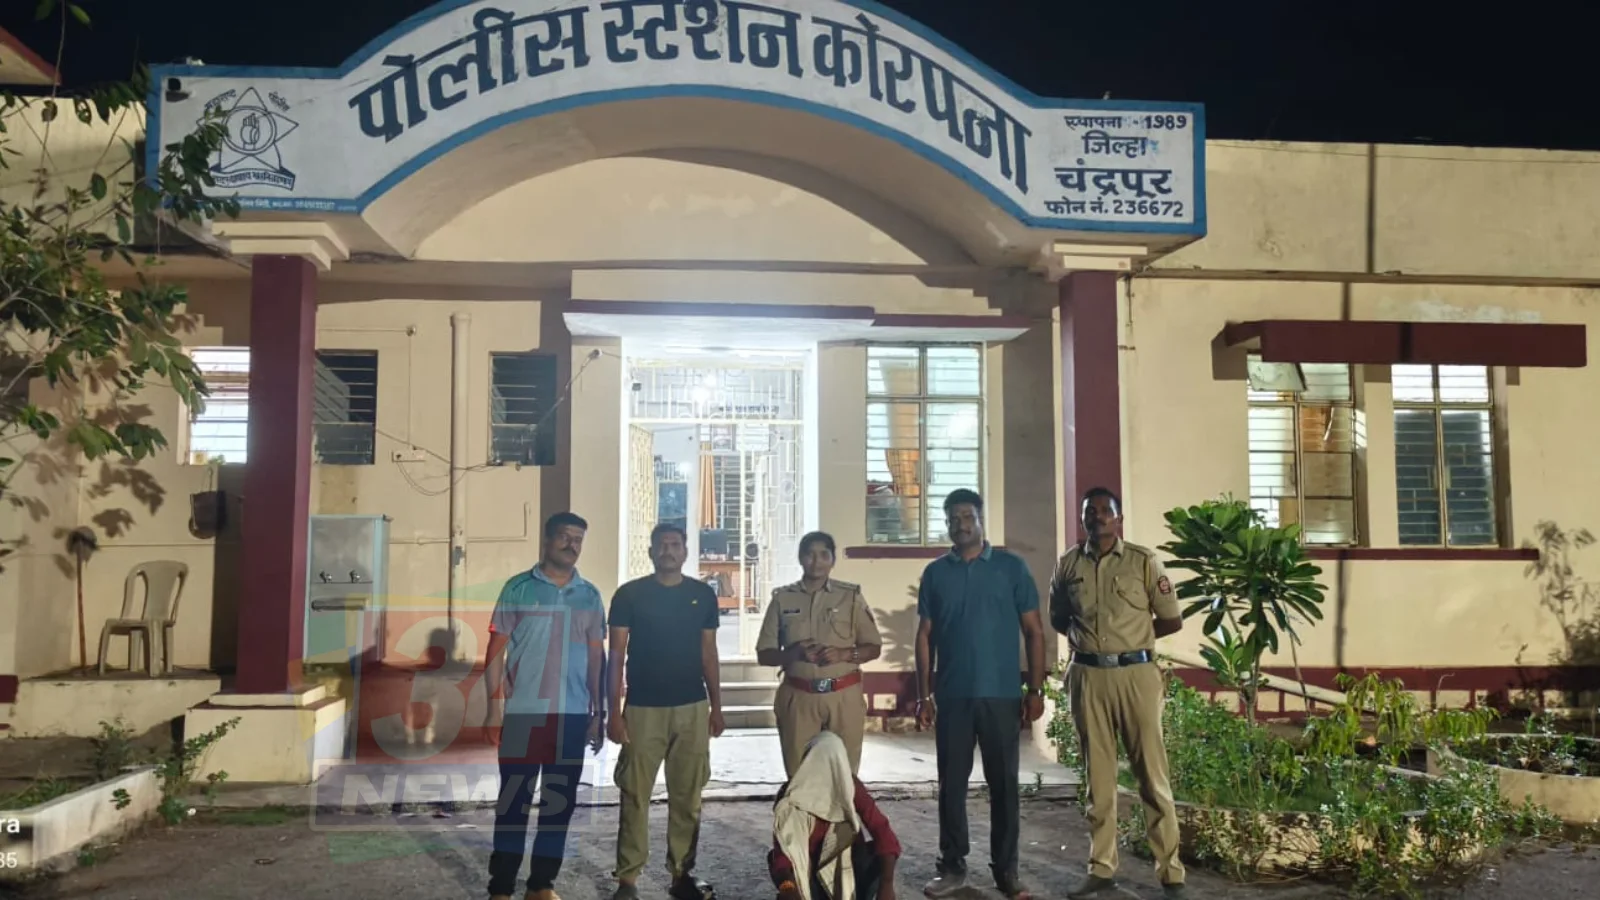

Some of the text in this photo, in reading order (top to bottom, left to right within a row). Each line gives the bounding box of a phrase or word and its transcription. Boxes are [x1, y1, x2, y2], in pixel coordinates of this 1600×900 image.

[349, 6, 590, 143] पोलीस
[811, 13, 1032, 195] कोरपना
[1144, 114, 1188, 131] 1989
[1081, 129, 1148, 159] जिल्हा
[1053, 158, 1173, 199] चंद्रपूर
[1044, 196, 1087, 215] फोन
[1112, 199, 1184, 218] 236672
